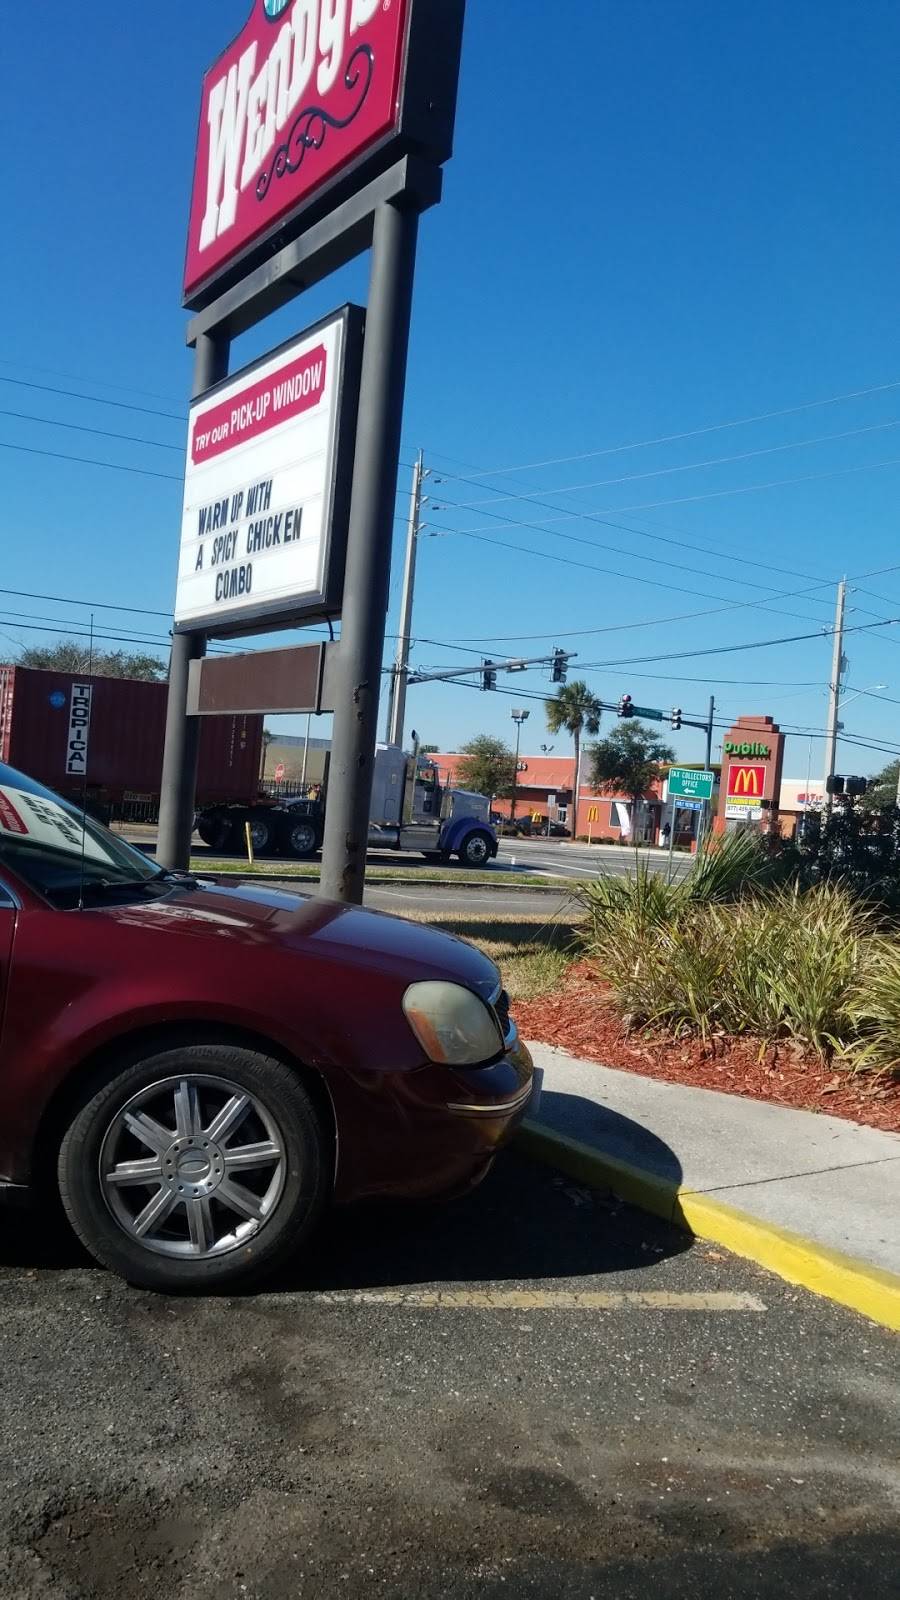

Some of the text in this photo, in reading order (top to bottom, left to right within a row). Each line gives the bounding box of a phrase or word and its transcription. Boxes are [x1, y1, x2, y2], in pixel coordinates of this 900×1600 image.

[195, 361, 322, 451] TRY OUR PICK-UP WINDOW
[198, 480, 273, 536] WARM UP WITH
[195, 507, 303, 571] A SPICY CHICKEN
[215, 562, 253, 601] COMBO
[68, 685, 90, 773] TROPICAL
[681, 771, 712, 782] COLLECTORS
[681, 780, 698, 788] OFFICE
